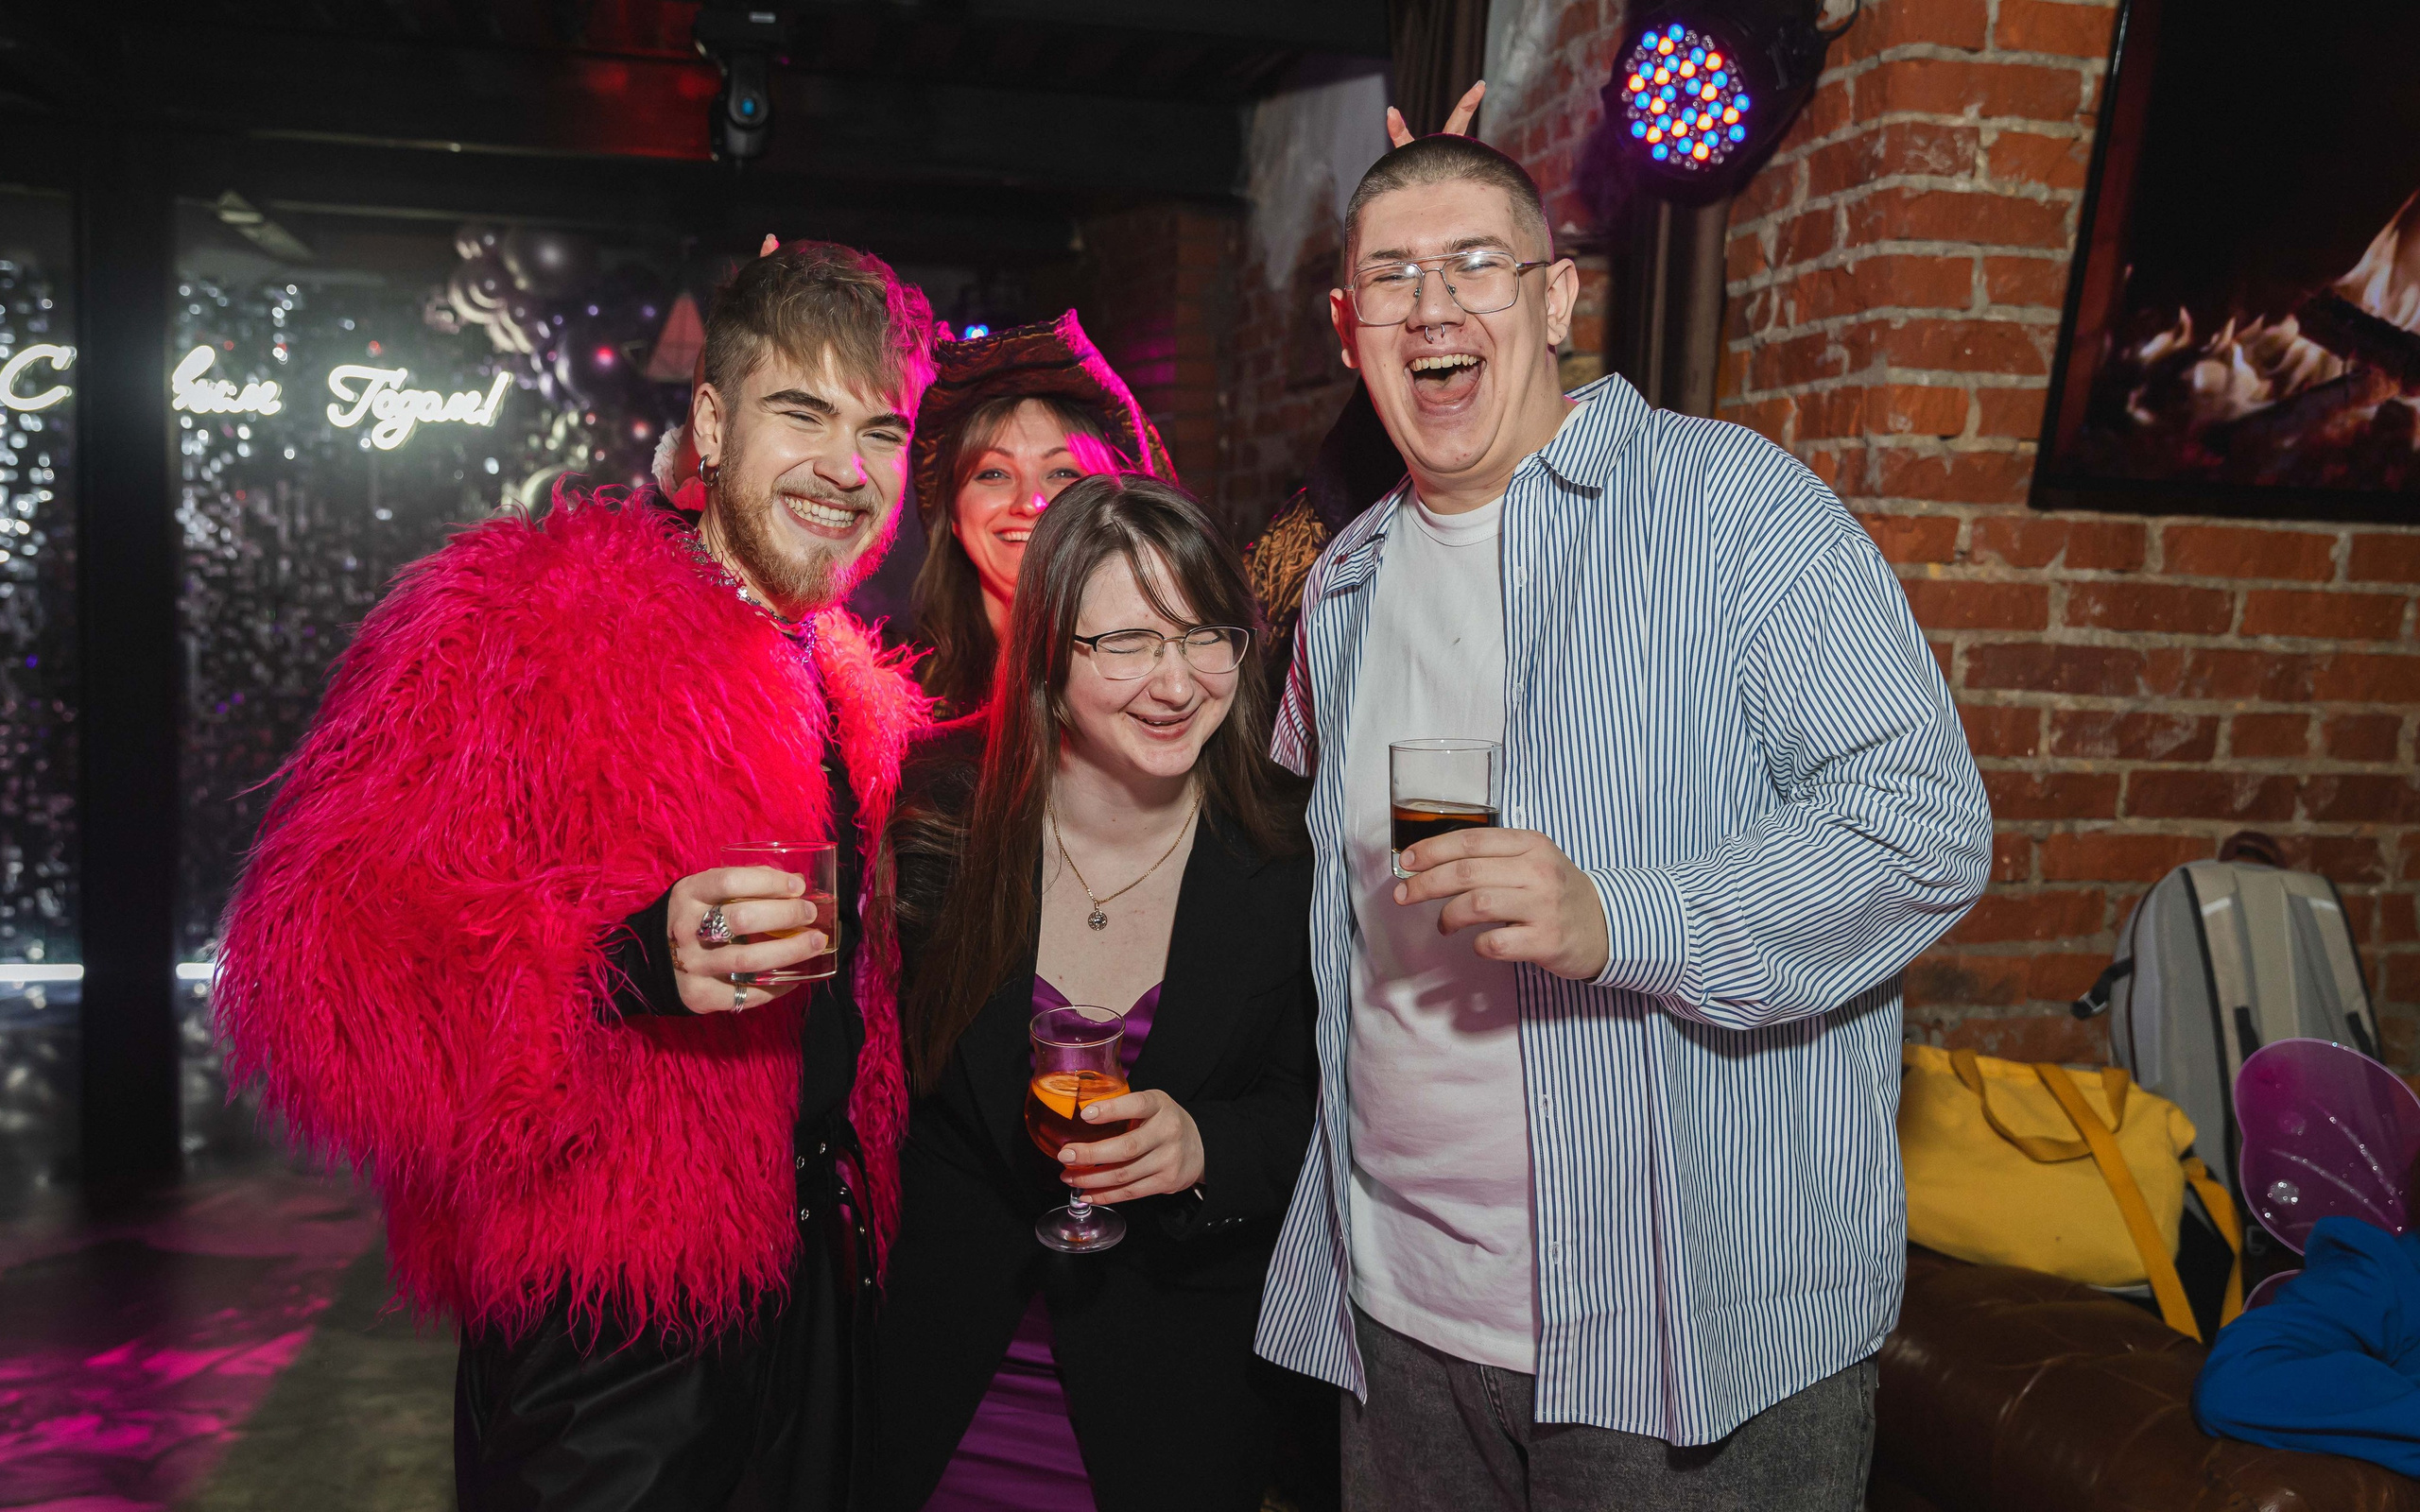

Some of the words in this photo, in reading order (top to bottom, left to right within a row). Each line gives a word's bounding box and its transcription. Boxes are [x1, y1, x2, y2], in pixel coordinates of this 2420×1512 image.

[0, 344, 73, 411] С
[172, 345, 282, 415] вым
[327, 365, 511, 450] Годом!
